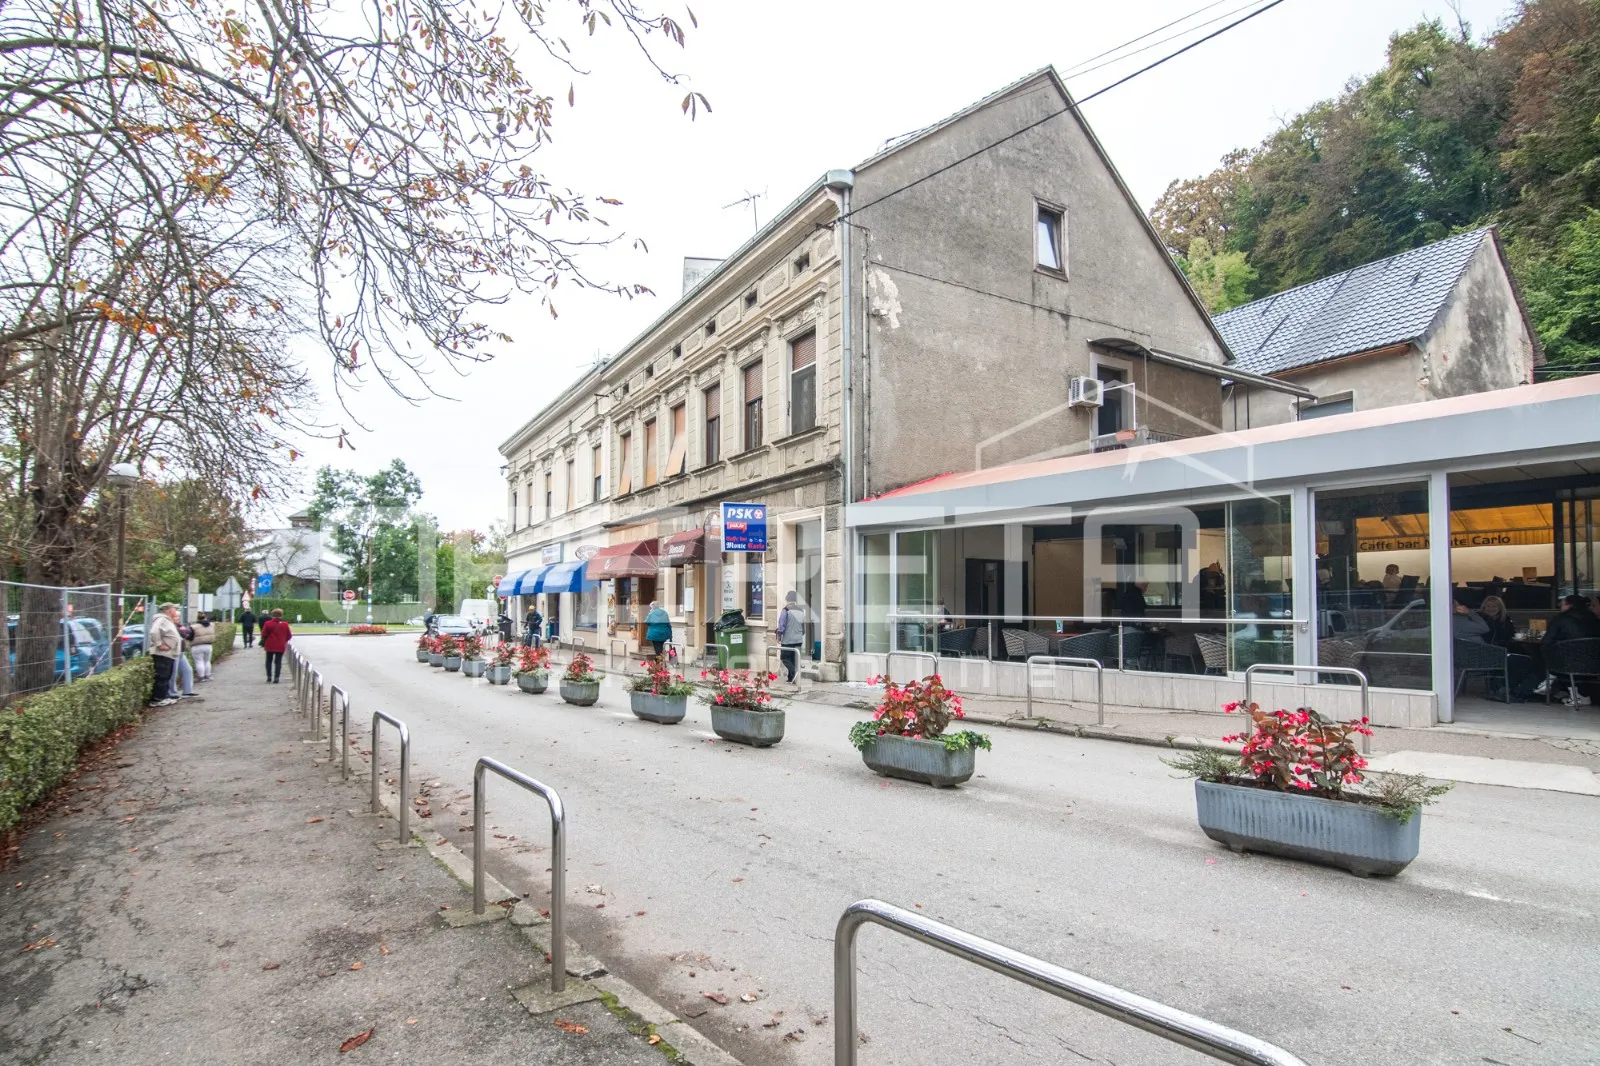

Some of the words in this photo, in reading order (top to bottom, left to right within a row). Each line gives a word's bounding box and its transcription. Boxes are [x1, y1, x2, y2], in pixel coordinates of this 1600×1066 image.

[727, 507, 754, 519] PSK
[1360, 541, 1392, 551] Caffe
[1397, 540, 1419, 549] bar
[1472, 534, 1511, 545] Carlo
